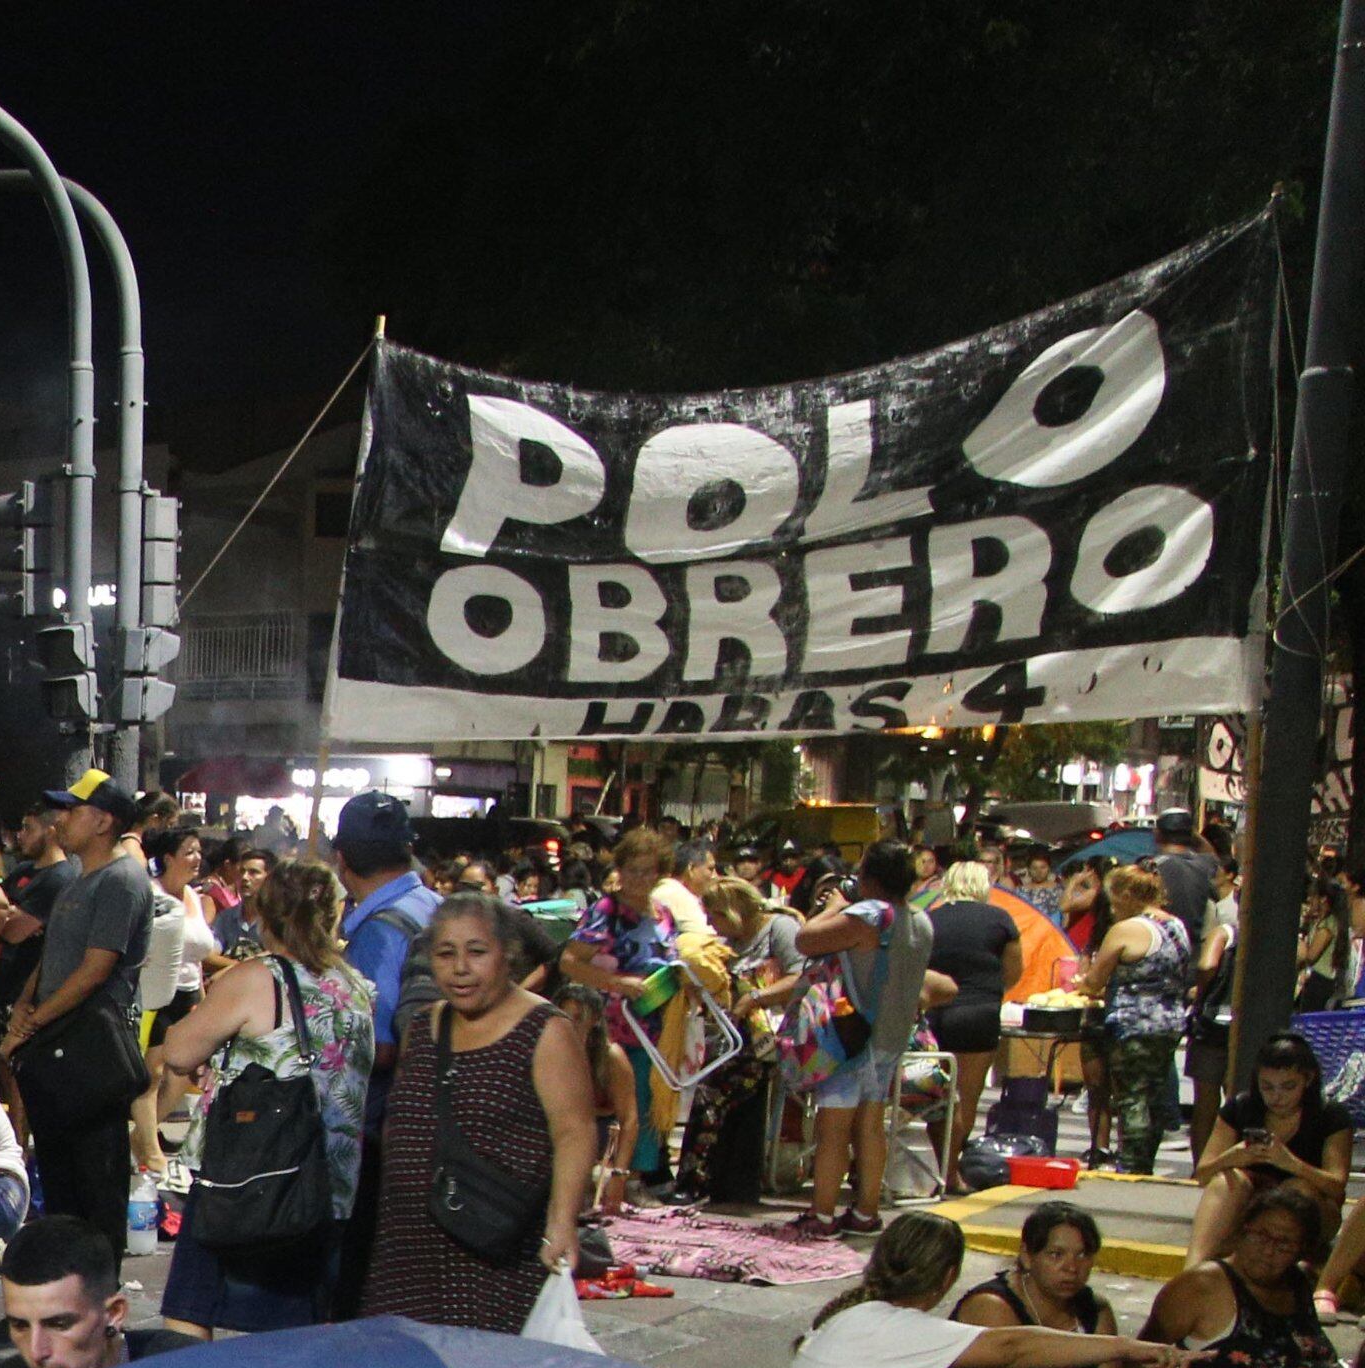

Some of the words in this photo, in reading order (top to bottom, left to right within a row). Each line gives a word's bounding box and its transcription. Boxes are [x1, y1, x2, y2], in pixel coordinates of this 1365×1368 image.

[440, 308, 1166, 563] POLO
[427, 484, 1215, 683] OBRERO
[961, 659, 1046, 724] 4
